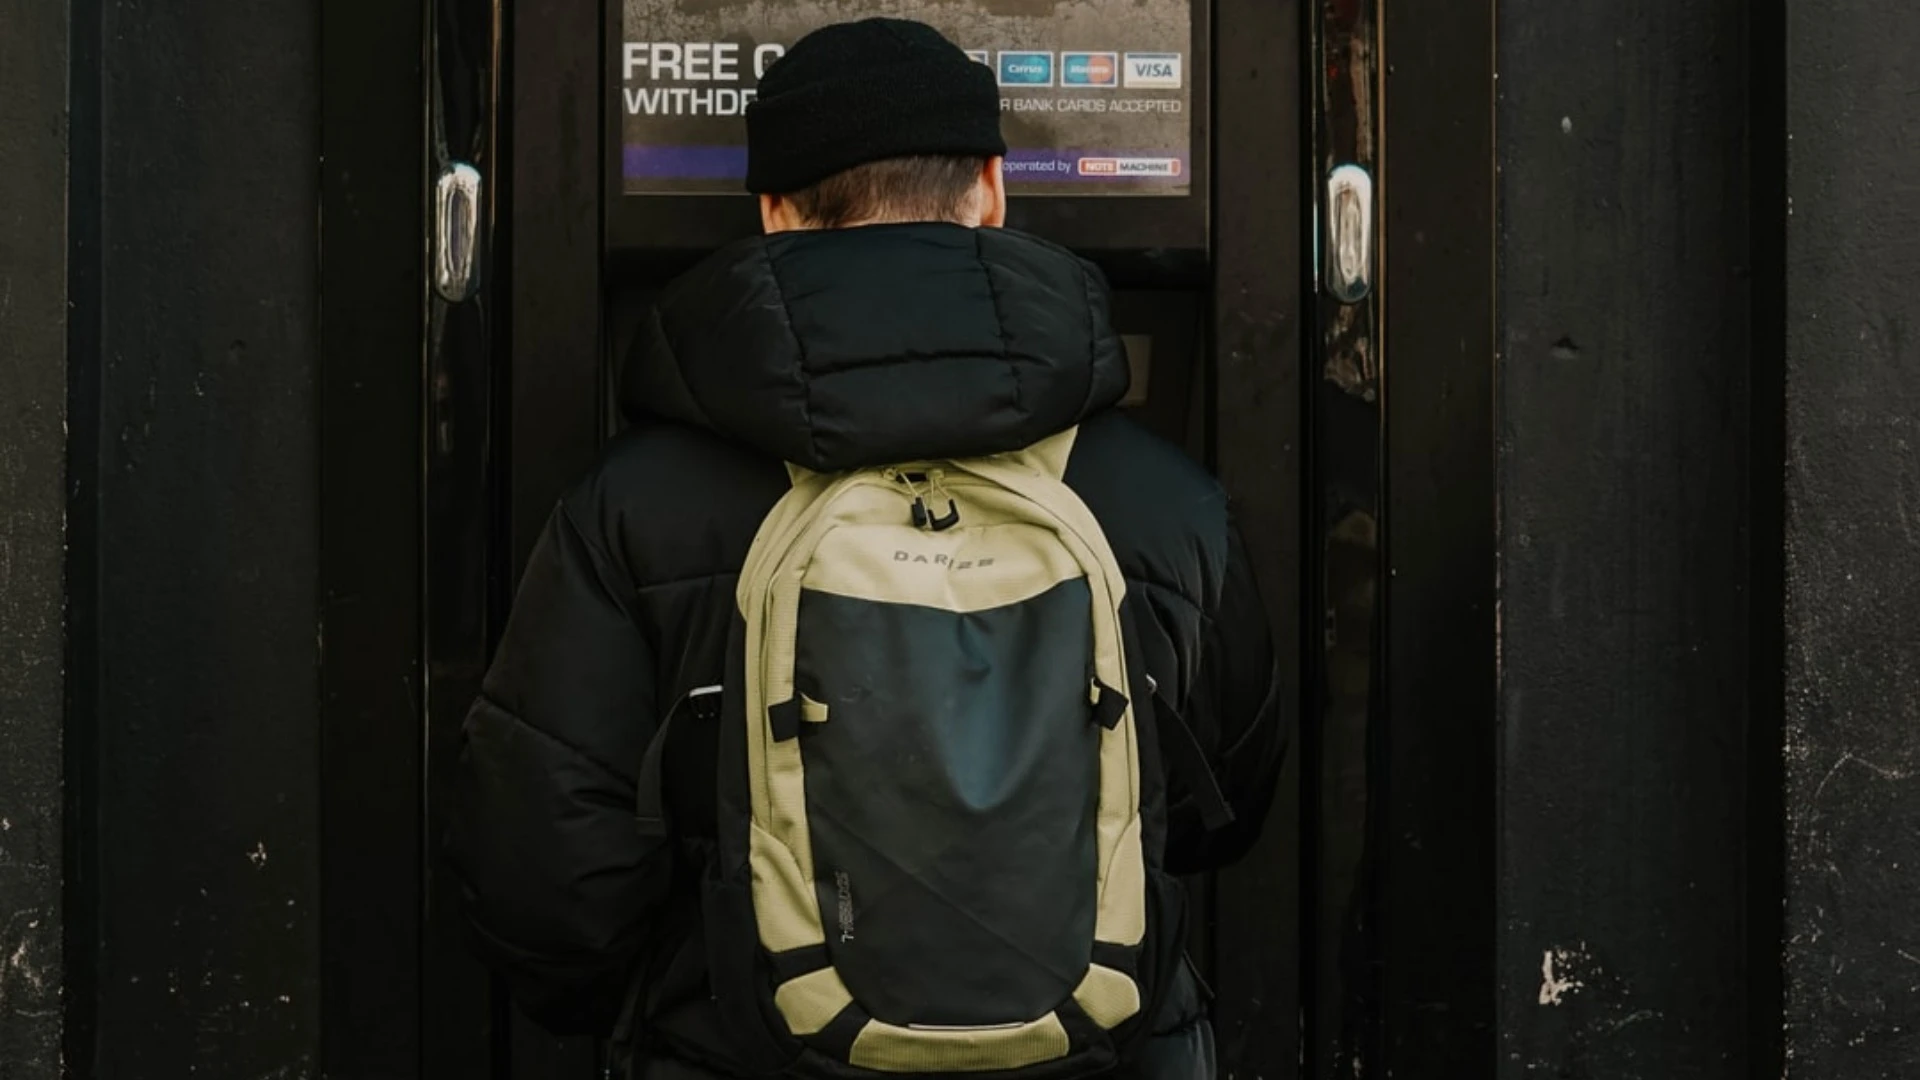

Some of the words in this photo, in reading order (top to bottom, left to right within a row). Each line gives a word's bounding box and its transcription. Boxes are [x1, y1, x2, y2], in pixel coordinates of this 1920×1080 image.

[623, 42, 739, 80] FREE
[1135, 63, 1173, 77] VISA
[1013, 98, 1054, 112] BANK
[1057, 99, 1106, 113] CARDS
[1109, 99, 1182, 113] ACCEPTED
[1003, 159, 1055, 173] operated
[1057, 159, 1072, 174] by
[1119, 162, 1169, 172] MACHINE
